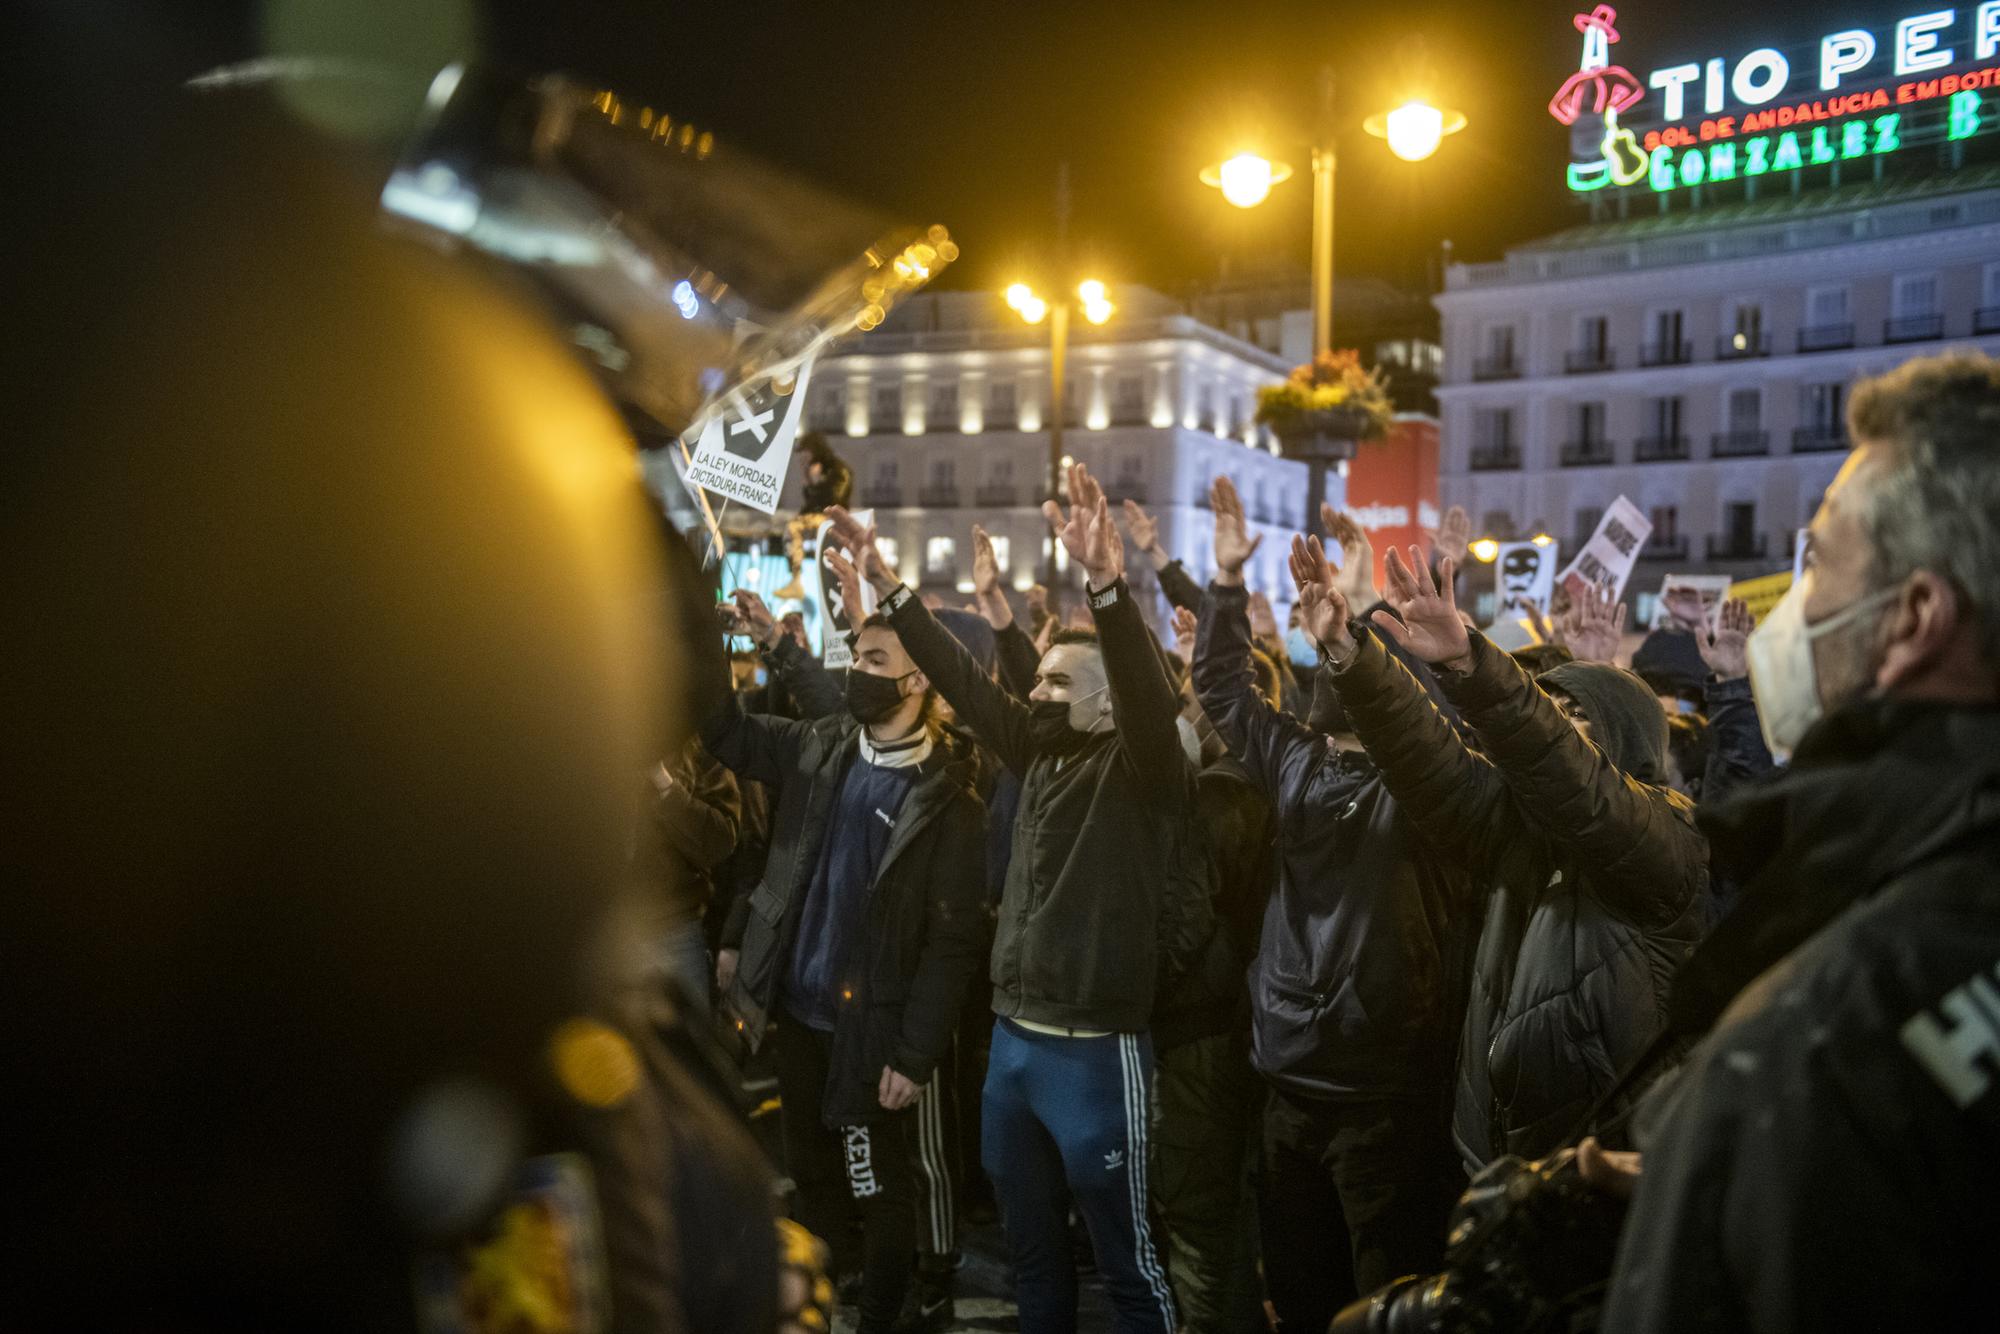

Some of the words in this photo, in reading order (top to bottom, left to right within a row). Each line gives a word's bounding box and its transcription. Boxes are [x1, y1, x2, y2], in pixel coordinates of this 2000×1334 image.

[1649, 48, 1790, 121] TIO
[1644, 126, 1697, 151] SOL
[1701, 116, 1736, 141] DE
[1740, 89, 1890, 134] ANDALUCIA
[1649, 112, 1901, 192] GONZALEZ
[690, 467, 738, 494] DICTADURA
[696, 450, 709, 464] LA
[709, 455, 730, 472] LEY
[728, 463, 778, 492] MORDAZA,
[1094, 586, 1118, 609] NIKE
